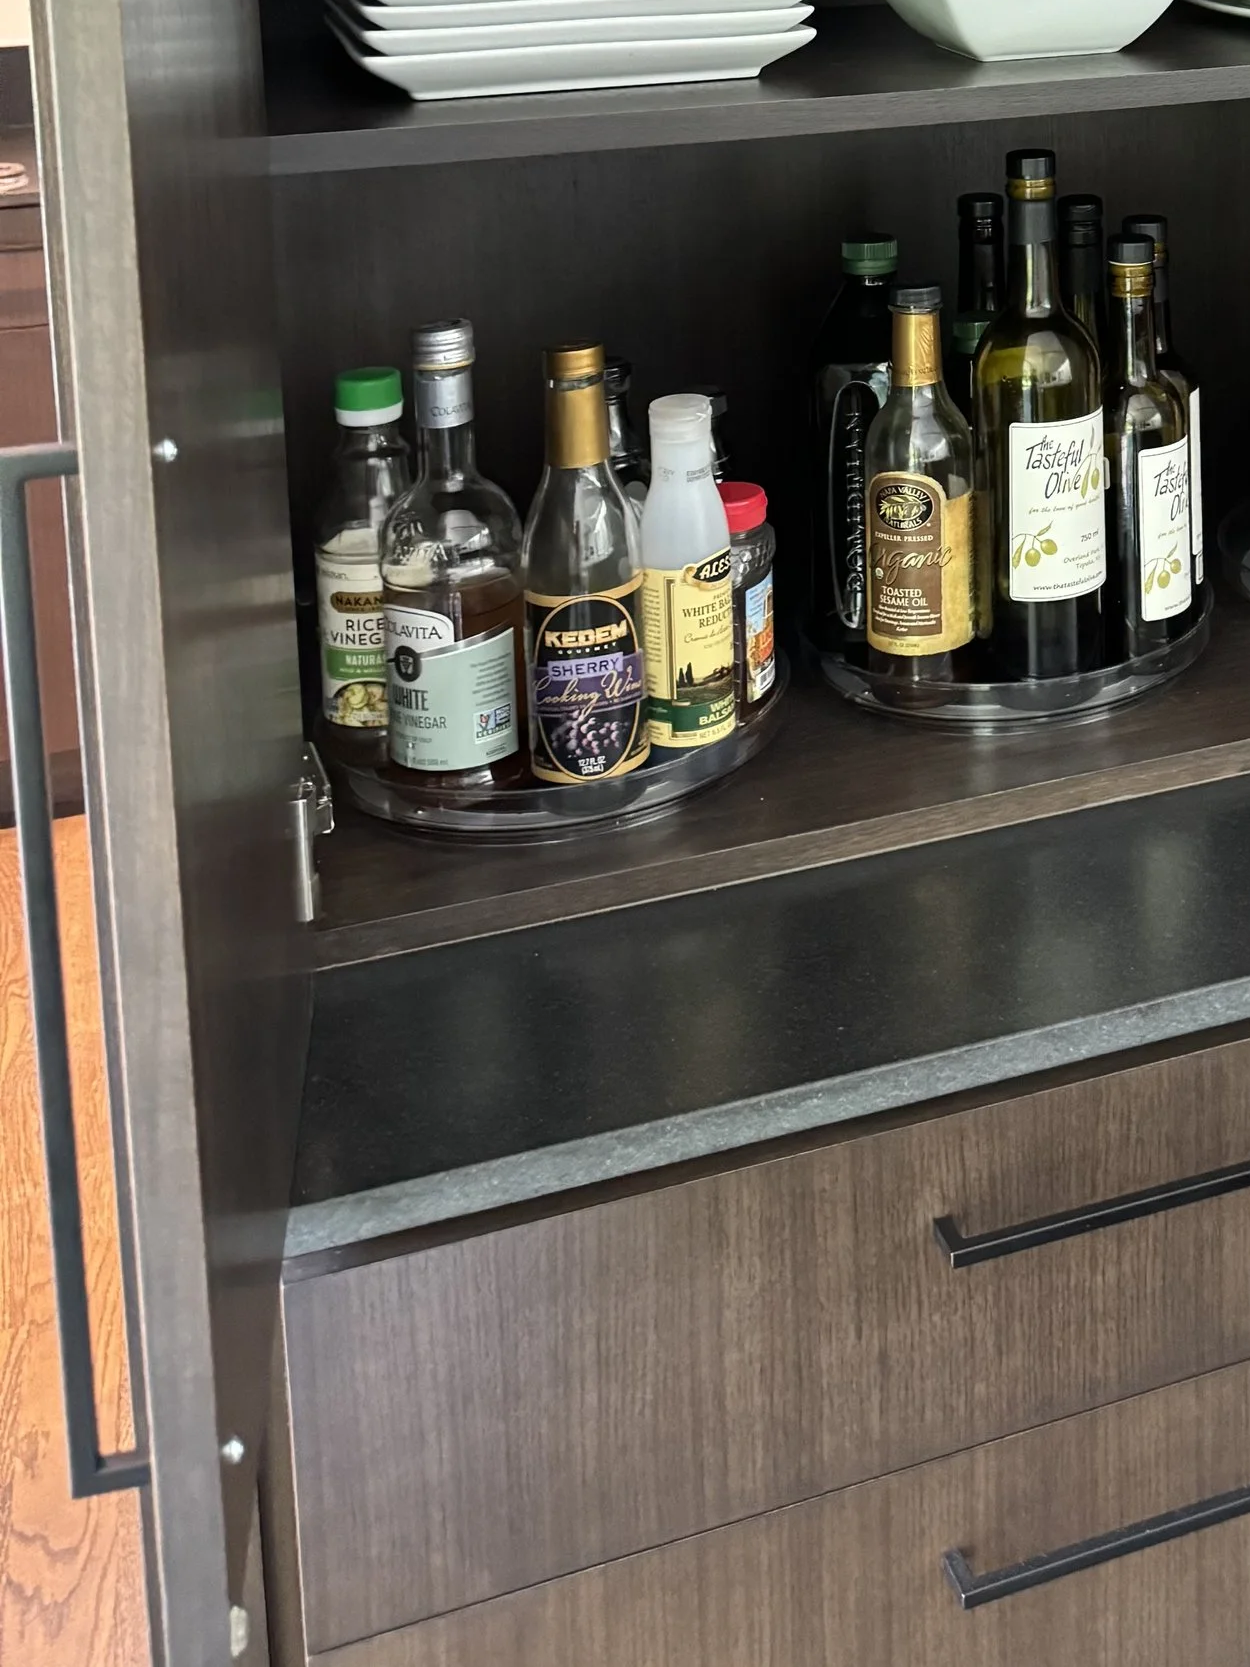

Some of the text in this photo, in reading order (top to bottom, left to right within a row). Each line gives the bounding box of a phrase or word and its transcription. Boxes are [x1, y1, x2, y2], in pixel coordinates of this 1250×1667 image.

[1025, 438, 1085, 473] Tasteful
[1044, 470, 1082, 499] Olive
[903, 534, 934, 542] PRESSED
[868, 542, 953, 586] Organic
[881, 585, 923, 598] TOASTED
[879, 594, 929, 607] SESAME OIL
[682, 601, 717, 618] WHITE
[345, 617, 385, 632] RICE
[330, 630, 382, 646] VINEG
[544, 619, 628, 648] KEDEM
[557, 641, 617, 655] GOURMET
[551, 657, 620, 677] SHERRY
[533, 675, 602, 724] Cooking
[404, 713, 447, 729] VINEGAR
